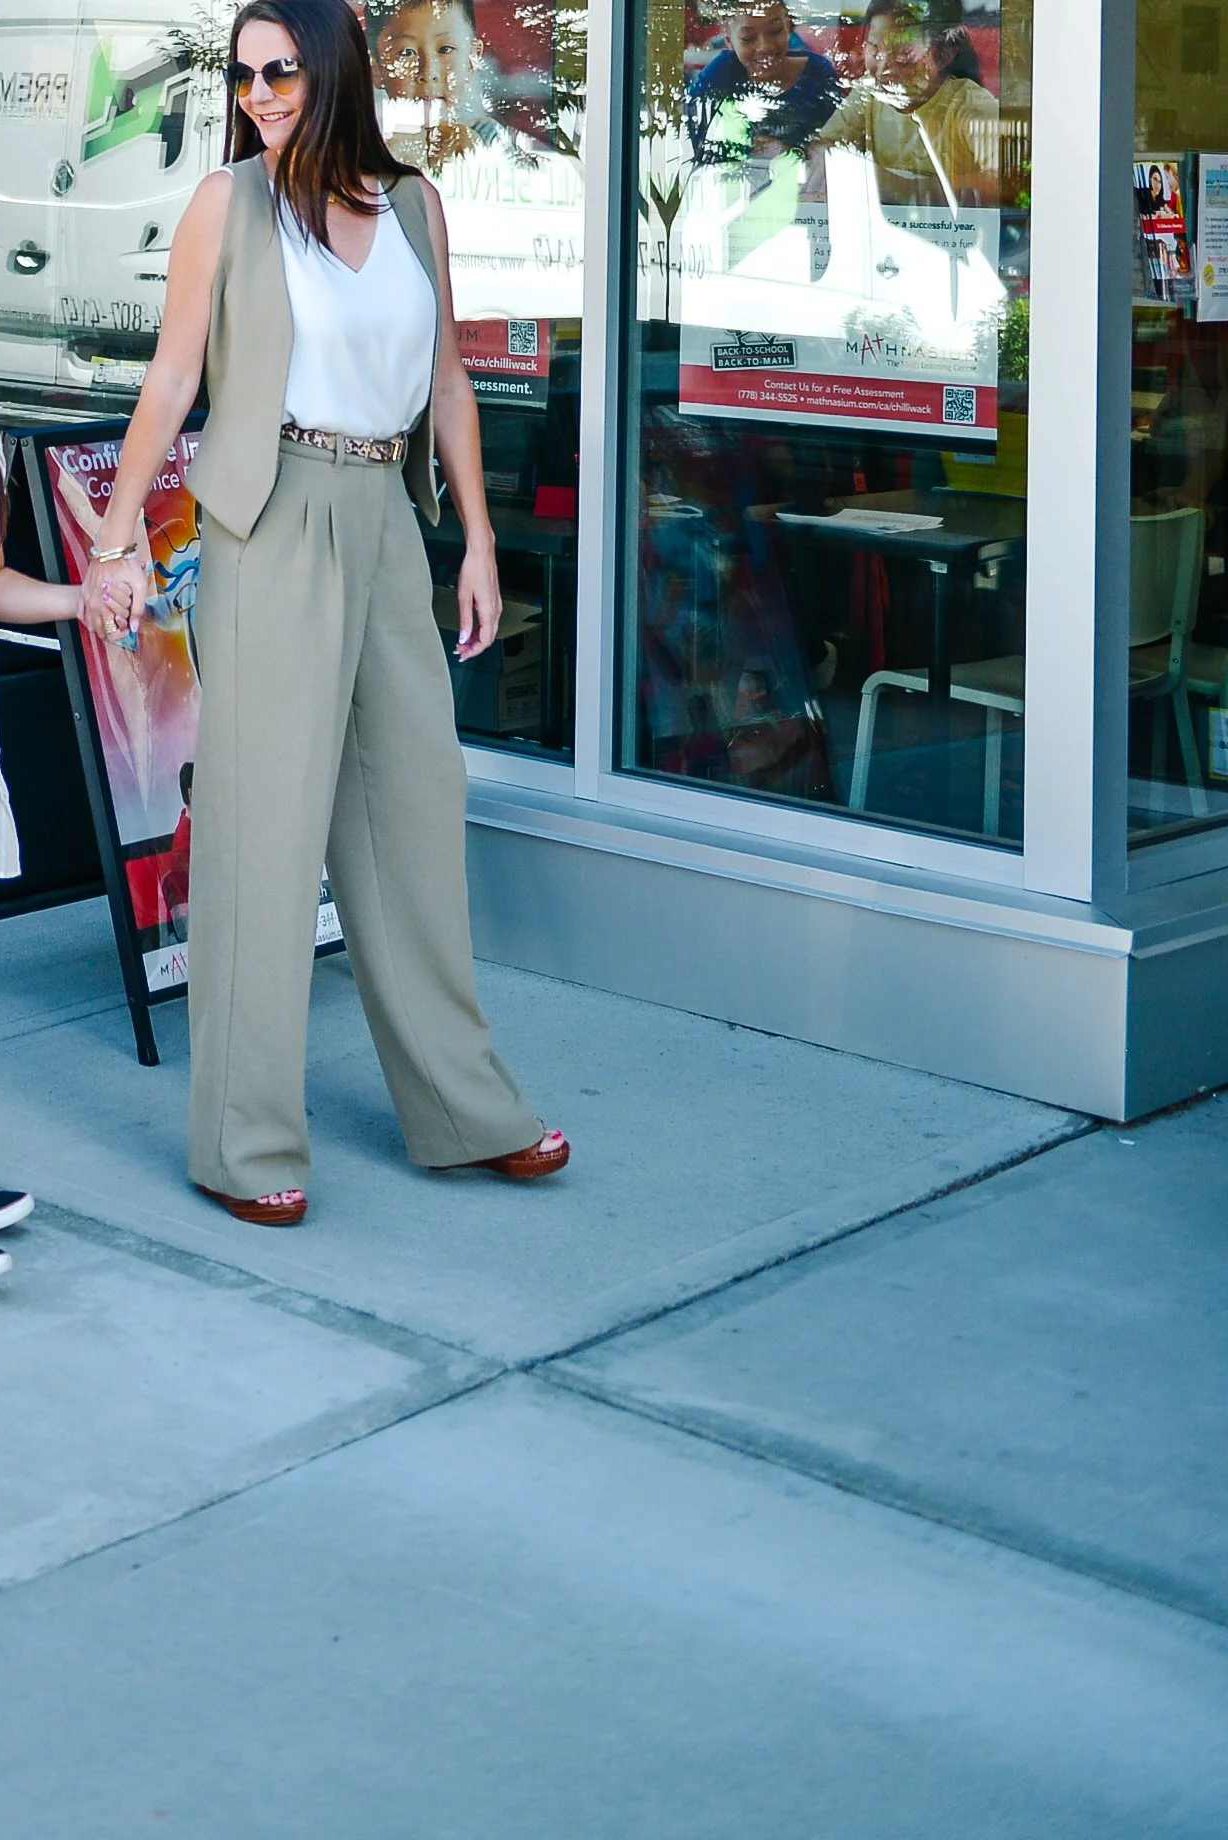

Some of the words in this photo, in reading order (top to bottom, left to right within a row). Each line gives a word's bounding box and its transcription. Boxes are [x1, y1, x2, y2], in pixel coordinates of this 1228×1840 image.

[794, 216, 816, 225] math
[909, 220, 951, 230] successful
[953, 223, 975, 232] year.
[717, 344, 789, 356] BACK-TO-SCHOOL
[717, 356, 790, 367] BACK-TO-MATH
[764, 379, 797, 391] Contact
[799, 382, 810, 392] Us
[811, 383, 823, 393] for
[832, 384, 852, 395] Free
[854, 386, 905, 398] Assessment
[737, 389, 758, 402] (778)
[759, 391, 798, 403] 344-5525
[806, 396, 932, 415] mathnasium.com/ca/chilliwack
